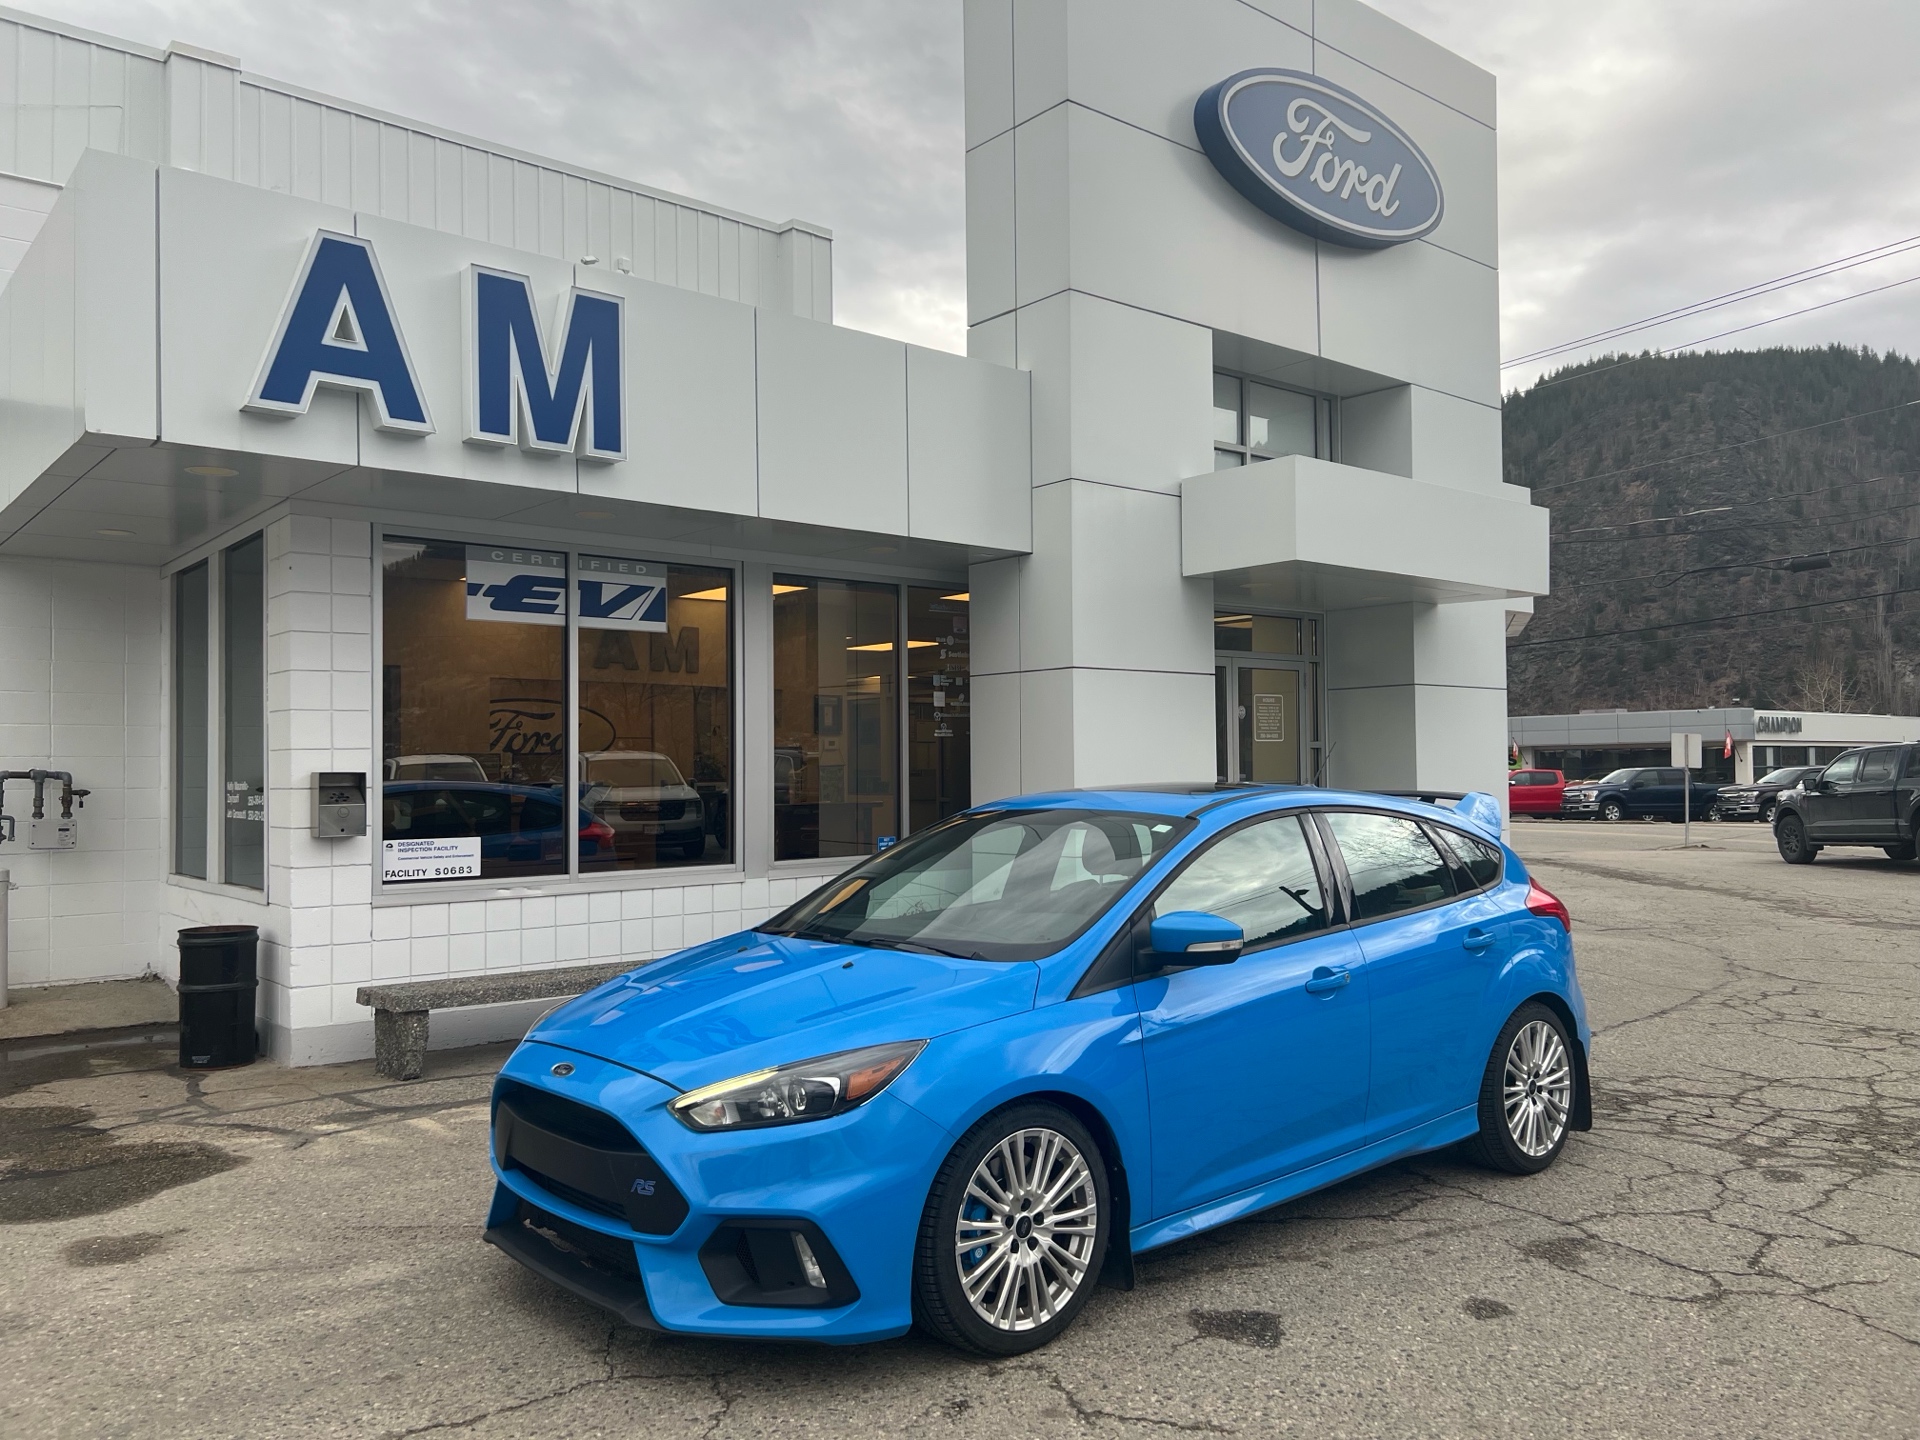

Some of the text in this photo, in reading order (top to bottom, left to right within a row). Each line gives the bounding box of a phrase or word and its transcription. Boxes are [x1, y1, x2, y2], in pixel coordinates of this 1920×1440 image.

[1272, 97, 1402, 217] Ford
[241, 229, 627, 462] AM
[491, 550, 647, 574] CERTIFIED
[1756, 715, 1803, 733] CHAMPION
[384, 866, 473, 878] FACILITY S0683
[630, 1178, 657, 1196] RS
